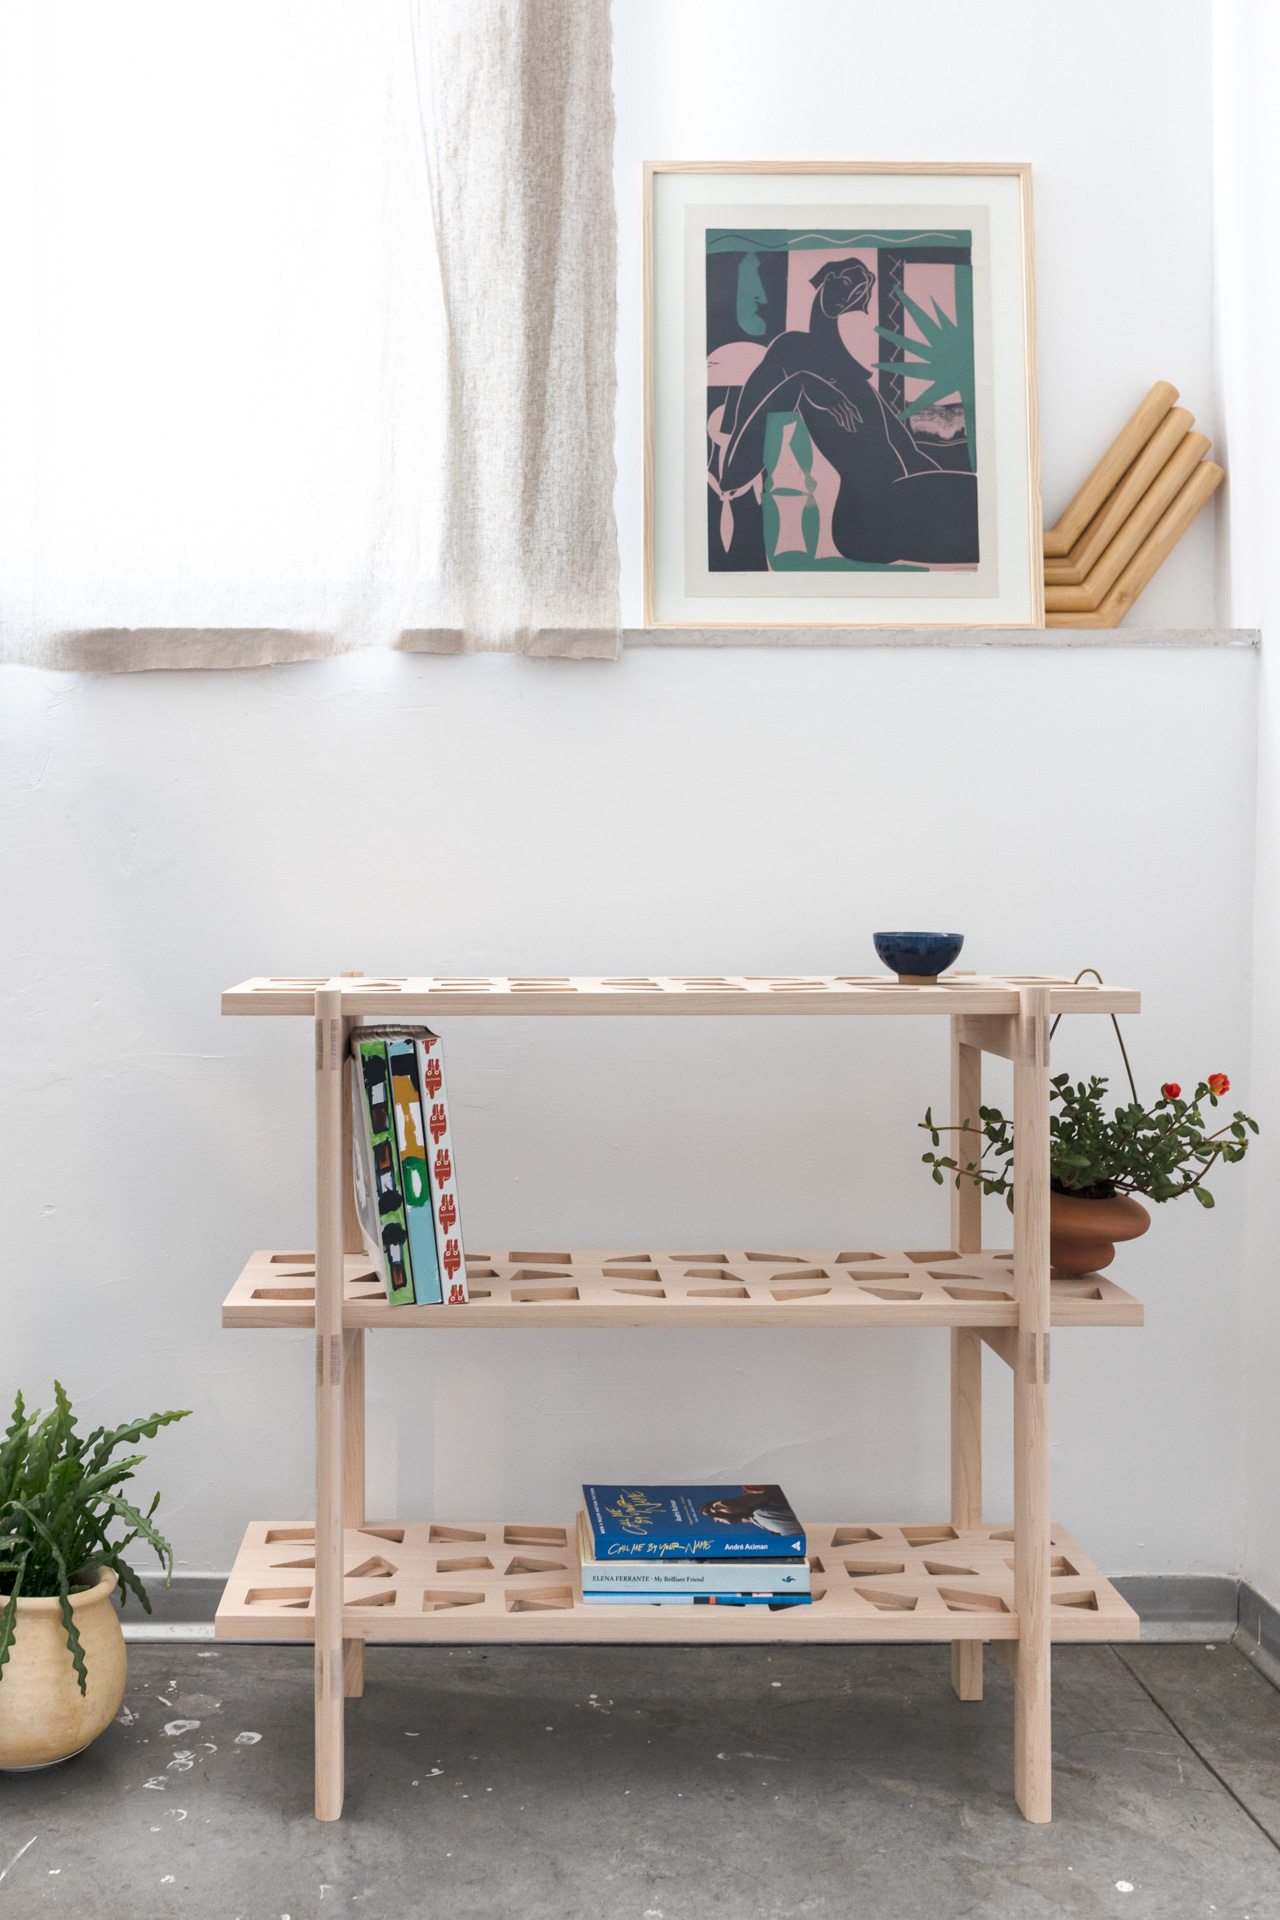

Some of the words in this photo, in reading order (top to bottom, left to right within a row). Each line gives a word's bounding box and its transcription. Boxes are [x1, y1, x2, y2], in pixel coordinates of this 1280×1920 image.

[607, 1543, 630, 1555] CALL
[630, 1543, 646, 1555] ME
[646, 1543, 657, 1554] BY
[658, 1542, 686, 1557] YOUR
[685, 1540, 715, 1554] NAME
